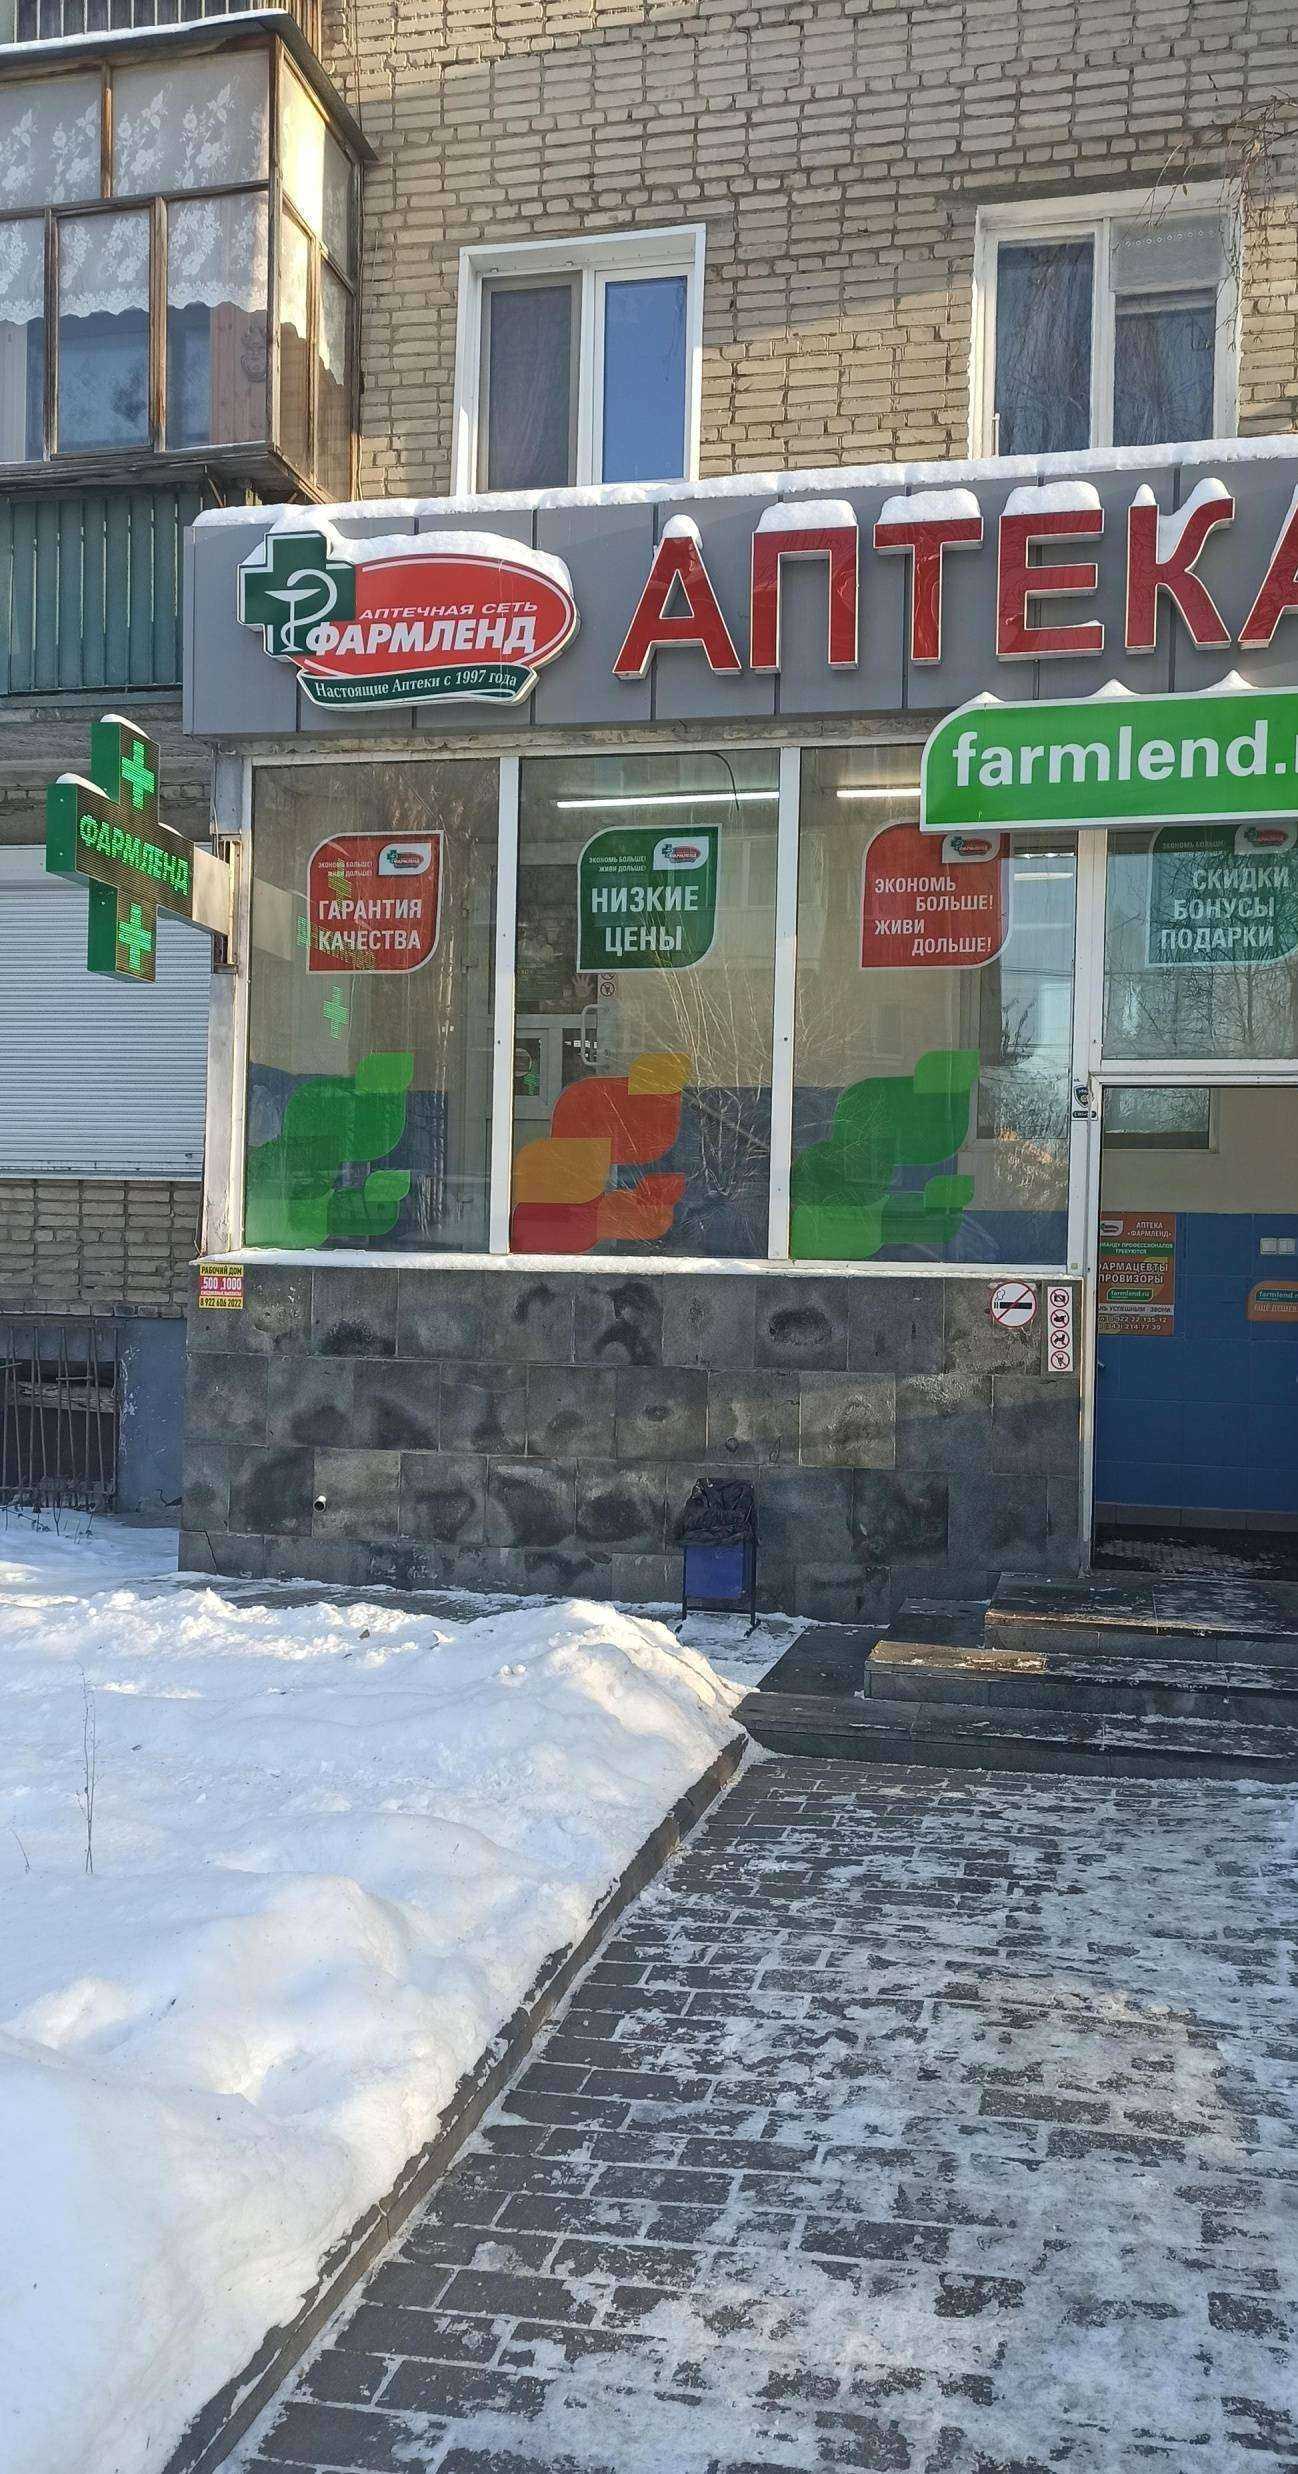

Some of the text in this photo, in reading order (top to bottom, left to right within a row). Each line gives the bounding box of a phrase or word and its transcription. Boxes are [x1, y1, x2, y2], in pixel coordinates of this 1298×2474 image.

[359, 601, 538, 620] АПТЕЧНАЯ СЕТЬ
[305, 616, 536, 656] ФАРМЛЕНД
[315, 670, 517, 698] Настоящие Аптеки с 1997 года
[952, 719, 1298, 788] farmlend.
[79, 814, 188, 896] ФАРМЛЕНД
[875, 876, 956, 893] ЭКОНОМЬ
[1193, 867, 1289, 892] СКИДКИ
[318, 899, 423, 920] ГАРАНТИЯ
[591, 885, 699, 913] НИЗКИЕ
[916, 895, 993, 912] БОЛЬШЕ!
[1173, 897, 1275, 920] БОНУСЫ
[875, 919, 925, 935] ЖИВИ
[318, 929, 421, 951] КАЧЕСТВА
[605, 925, 682, 957] ЦЕНЫ
[912, 937, 991, 956] ДОЛЬШЕ!
[1161, 926, 1274, 953] ПОДАРКИ
[1136, 1221, 1163, 1229] АПТЕКА
[201, 1265, 242, 1276] РАБОЧИЙ ДОМ
[1099, 1262, 1168, 1275] АРМАЦЕВТЫ
[1099, 1274, 1163, 1284] ПРОВИЗОРЫ
[205, 1298, 215, 1306] 922
